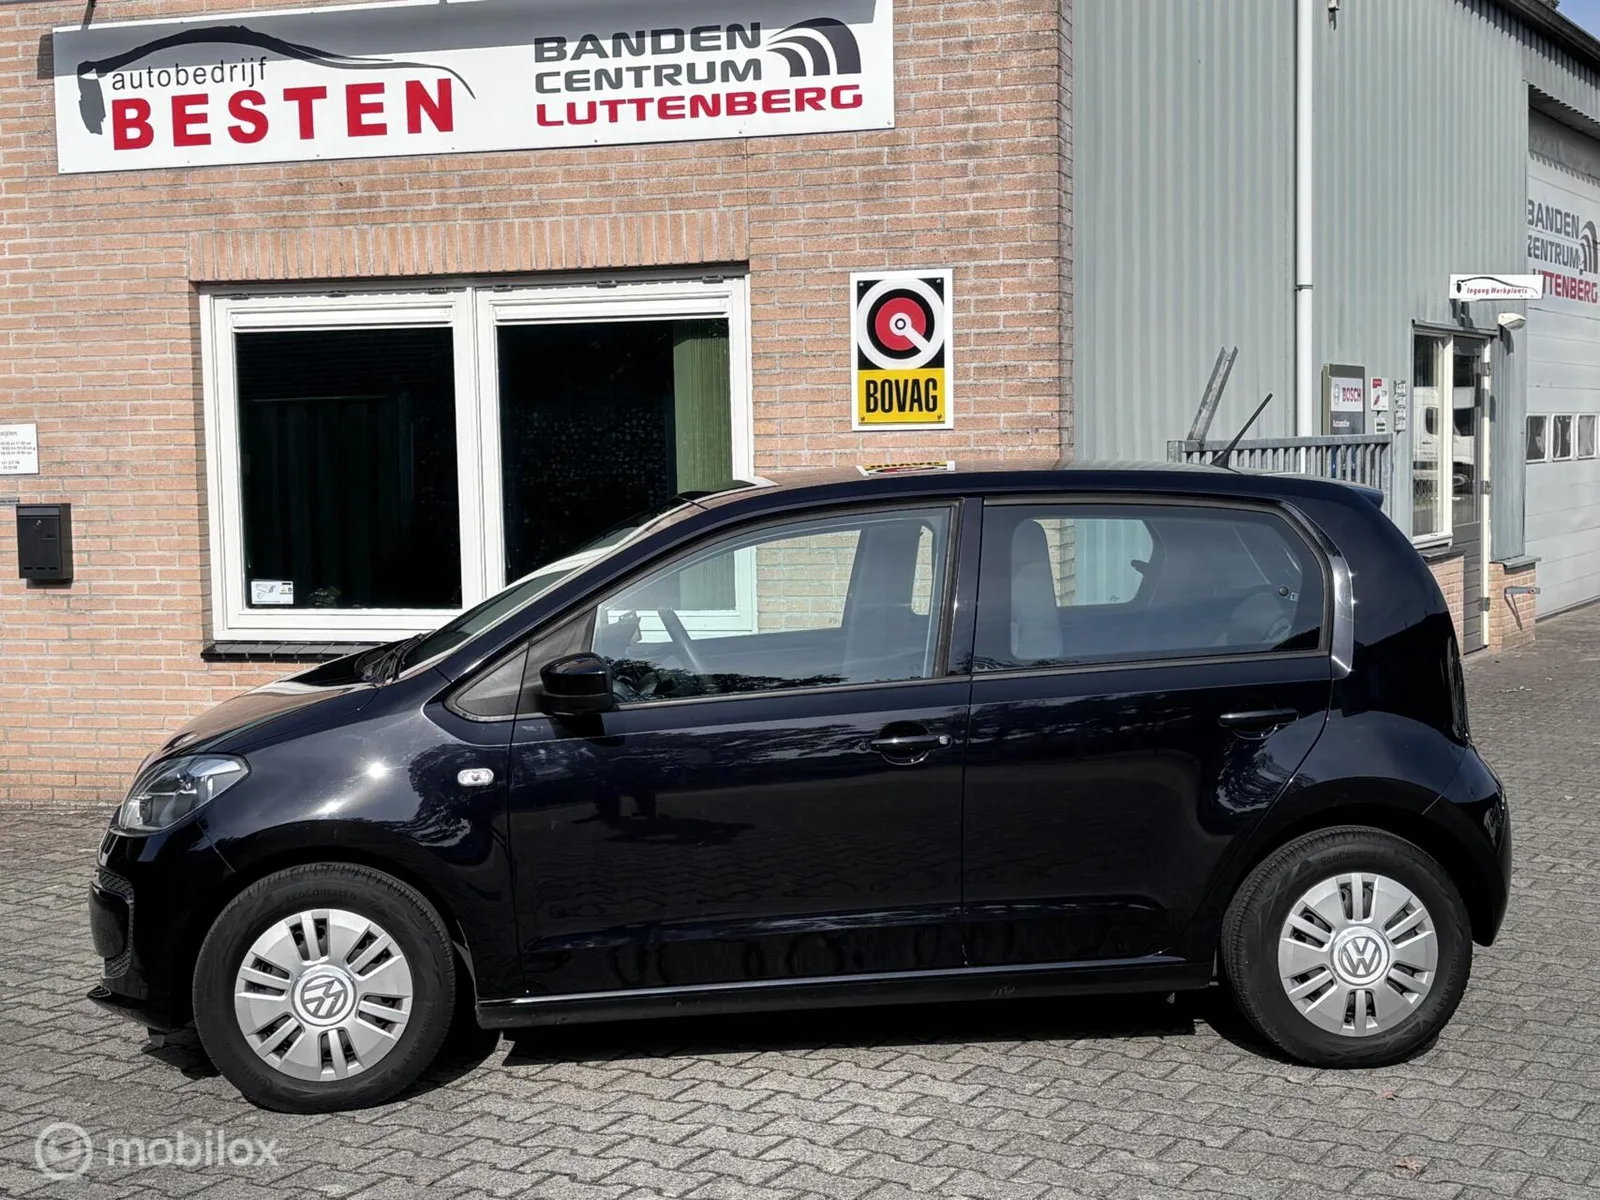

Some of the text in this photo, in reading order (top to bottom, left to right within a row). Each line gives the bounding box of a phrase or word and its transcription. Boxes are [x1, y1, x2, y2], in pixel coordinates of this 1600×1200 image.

[534, 21, 761, 64] BANDEN
[111, 56, 269, 91] autobedrijf
[535, 57, 762, 94] CENTRUM
[111, 78, 454, 151] BESTEN
[536, 84, 864, 128] LUTTENBERG
[865, 378, 938, 414] BOVAG
[1342, 387, 1361, 403] BOSCH
